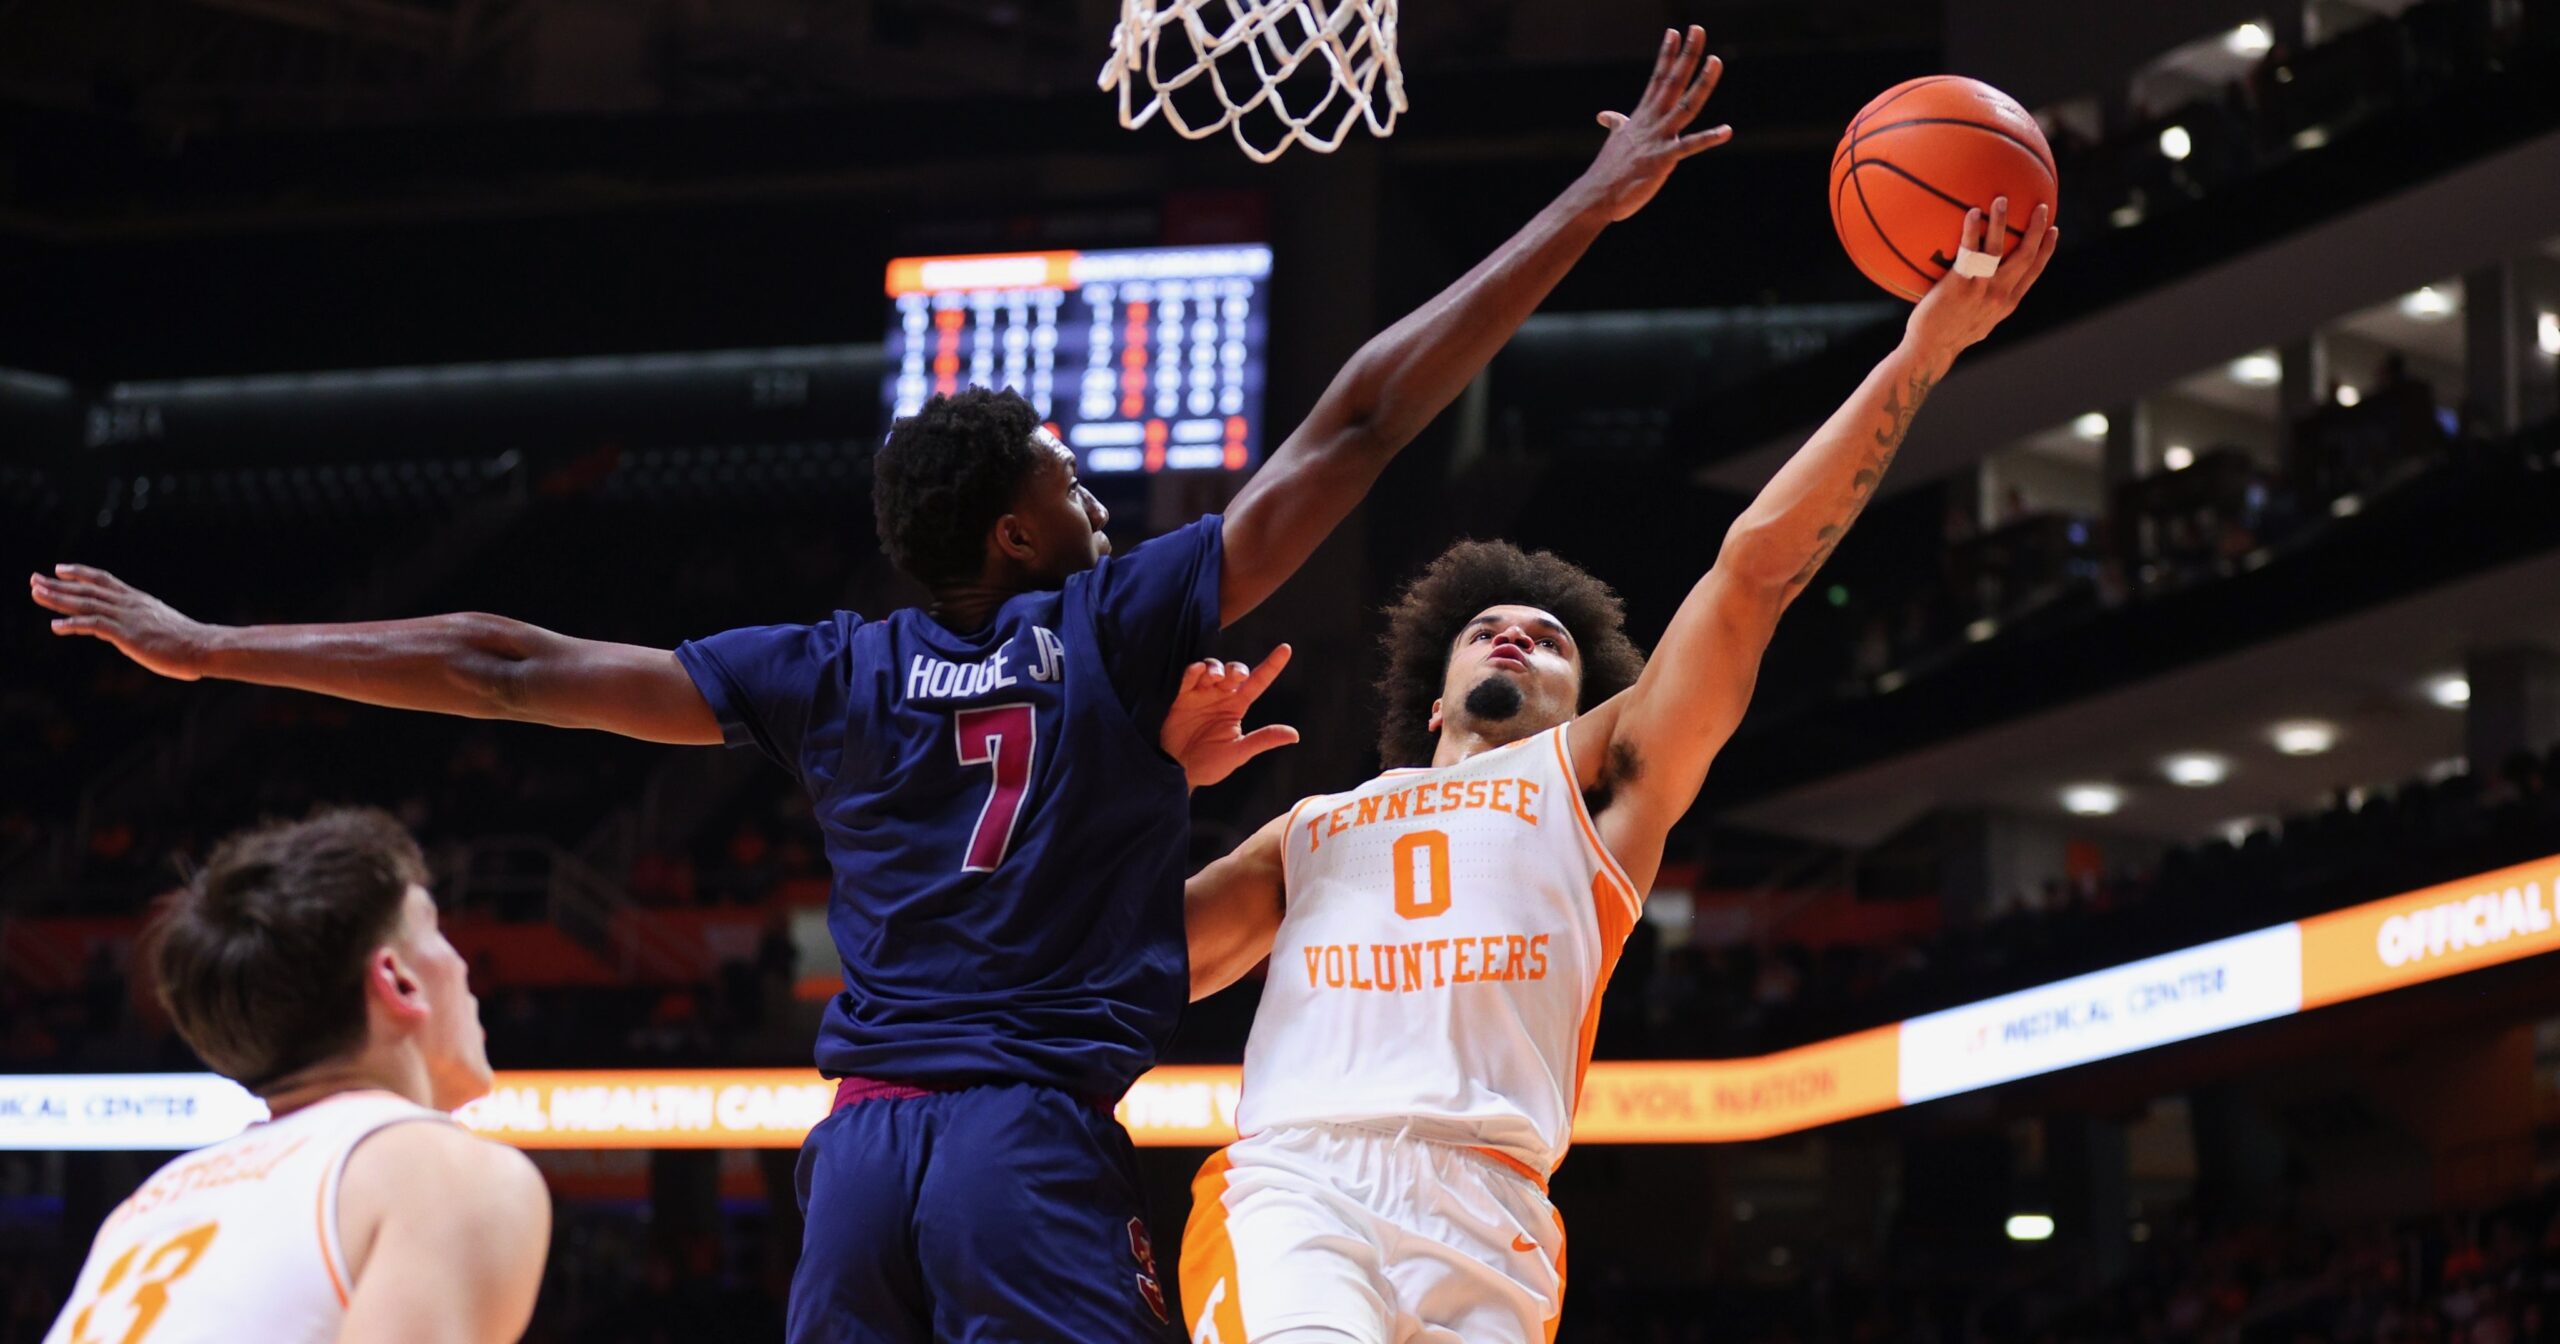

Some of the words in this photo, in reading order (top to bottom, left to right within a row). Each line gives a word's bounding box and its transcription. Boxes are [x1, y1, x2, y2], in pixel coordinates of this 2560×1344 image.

[906, 637, 1017, 699] HODGE
[954, 702, 1037, 873] 7
[1307, 778, 1541, 853] TENNESSEE
[1392, 829, 1452, 920] 0
[2377, 882, 2551, 968] OFFICIAL
[1303, 933, 1549, 993] VOLUNTEERS
[550, 1085, 714, 1132] HEALTH
